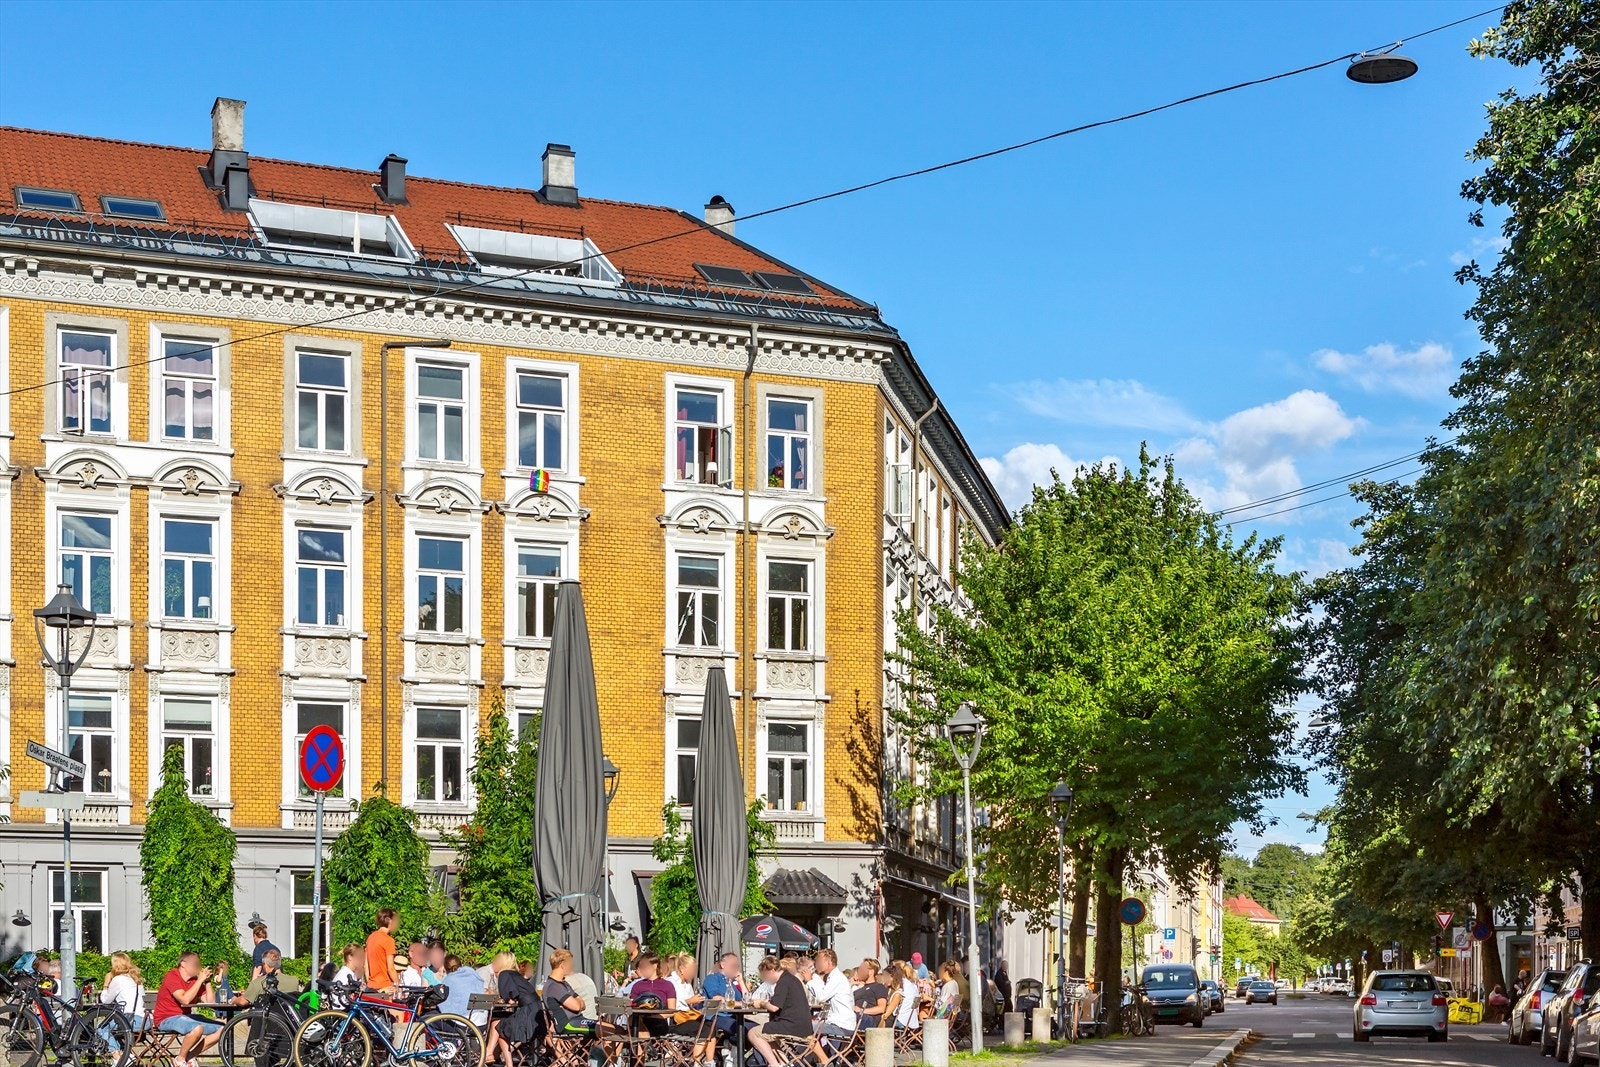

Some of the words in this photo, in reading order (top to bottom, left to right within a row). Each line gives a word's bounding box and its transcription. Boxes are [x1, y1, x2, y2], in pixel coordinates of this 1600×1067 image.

[29, 744, 45, 756] Oskar
[46, 751, 69, 767] Braatens
[70, 762, 83, 774] plass
[1166, 930, 1173, 938] P
